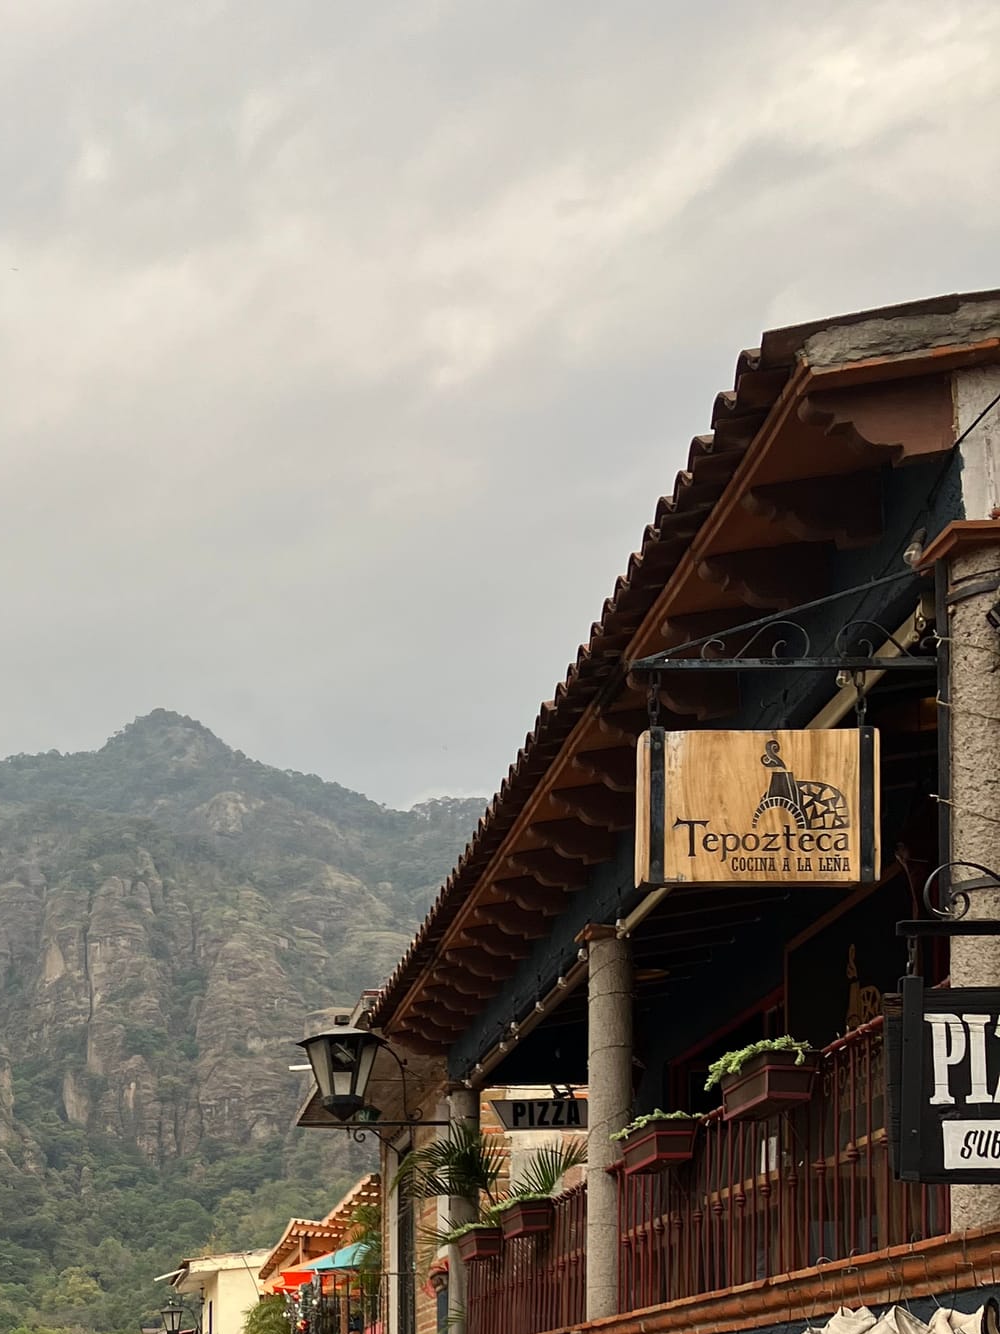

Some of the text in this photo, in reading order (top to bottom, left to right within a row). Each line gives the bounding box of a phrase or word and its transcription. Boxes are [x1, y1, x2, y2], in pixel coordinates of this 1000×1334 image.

[672, 816, 850, 863] Tepozteca
[731, 853, 850, 873] COCINA A LA LEÑA
[923, 1012, 1000, 1105] PI
[512, 1101, 580, 1126] PIZZA
